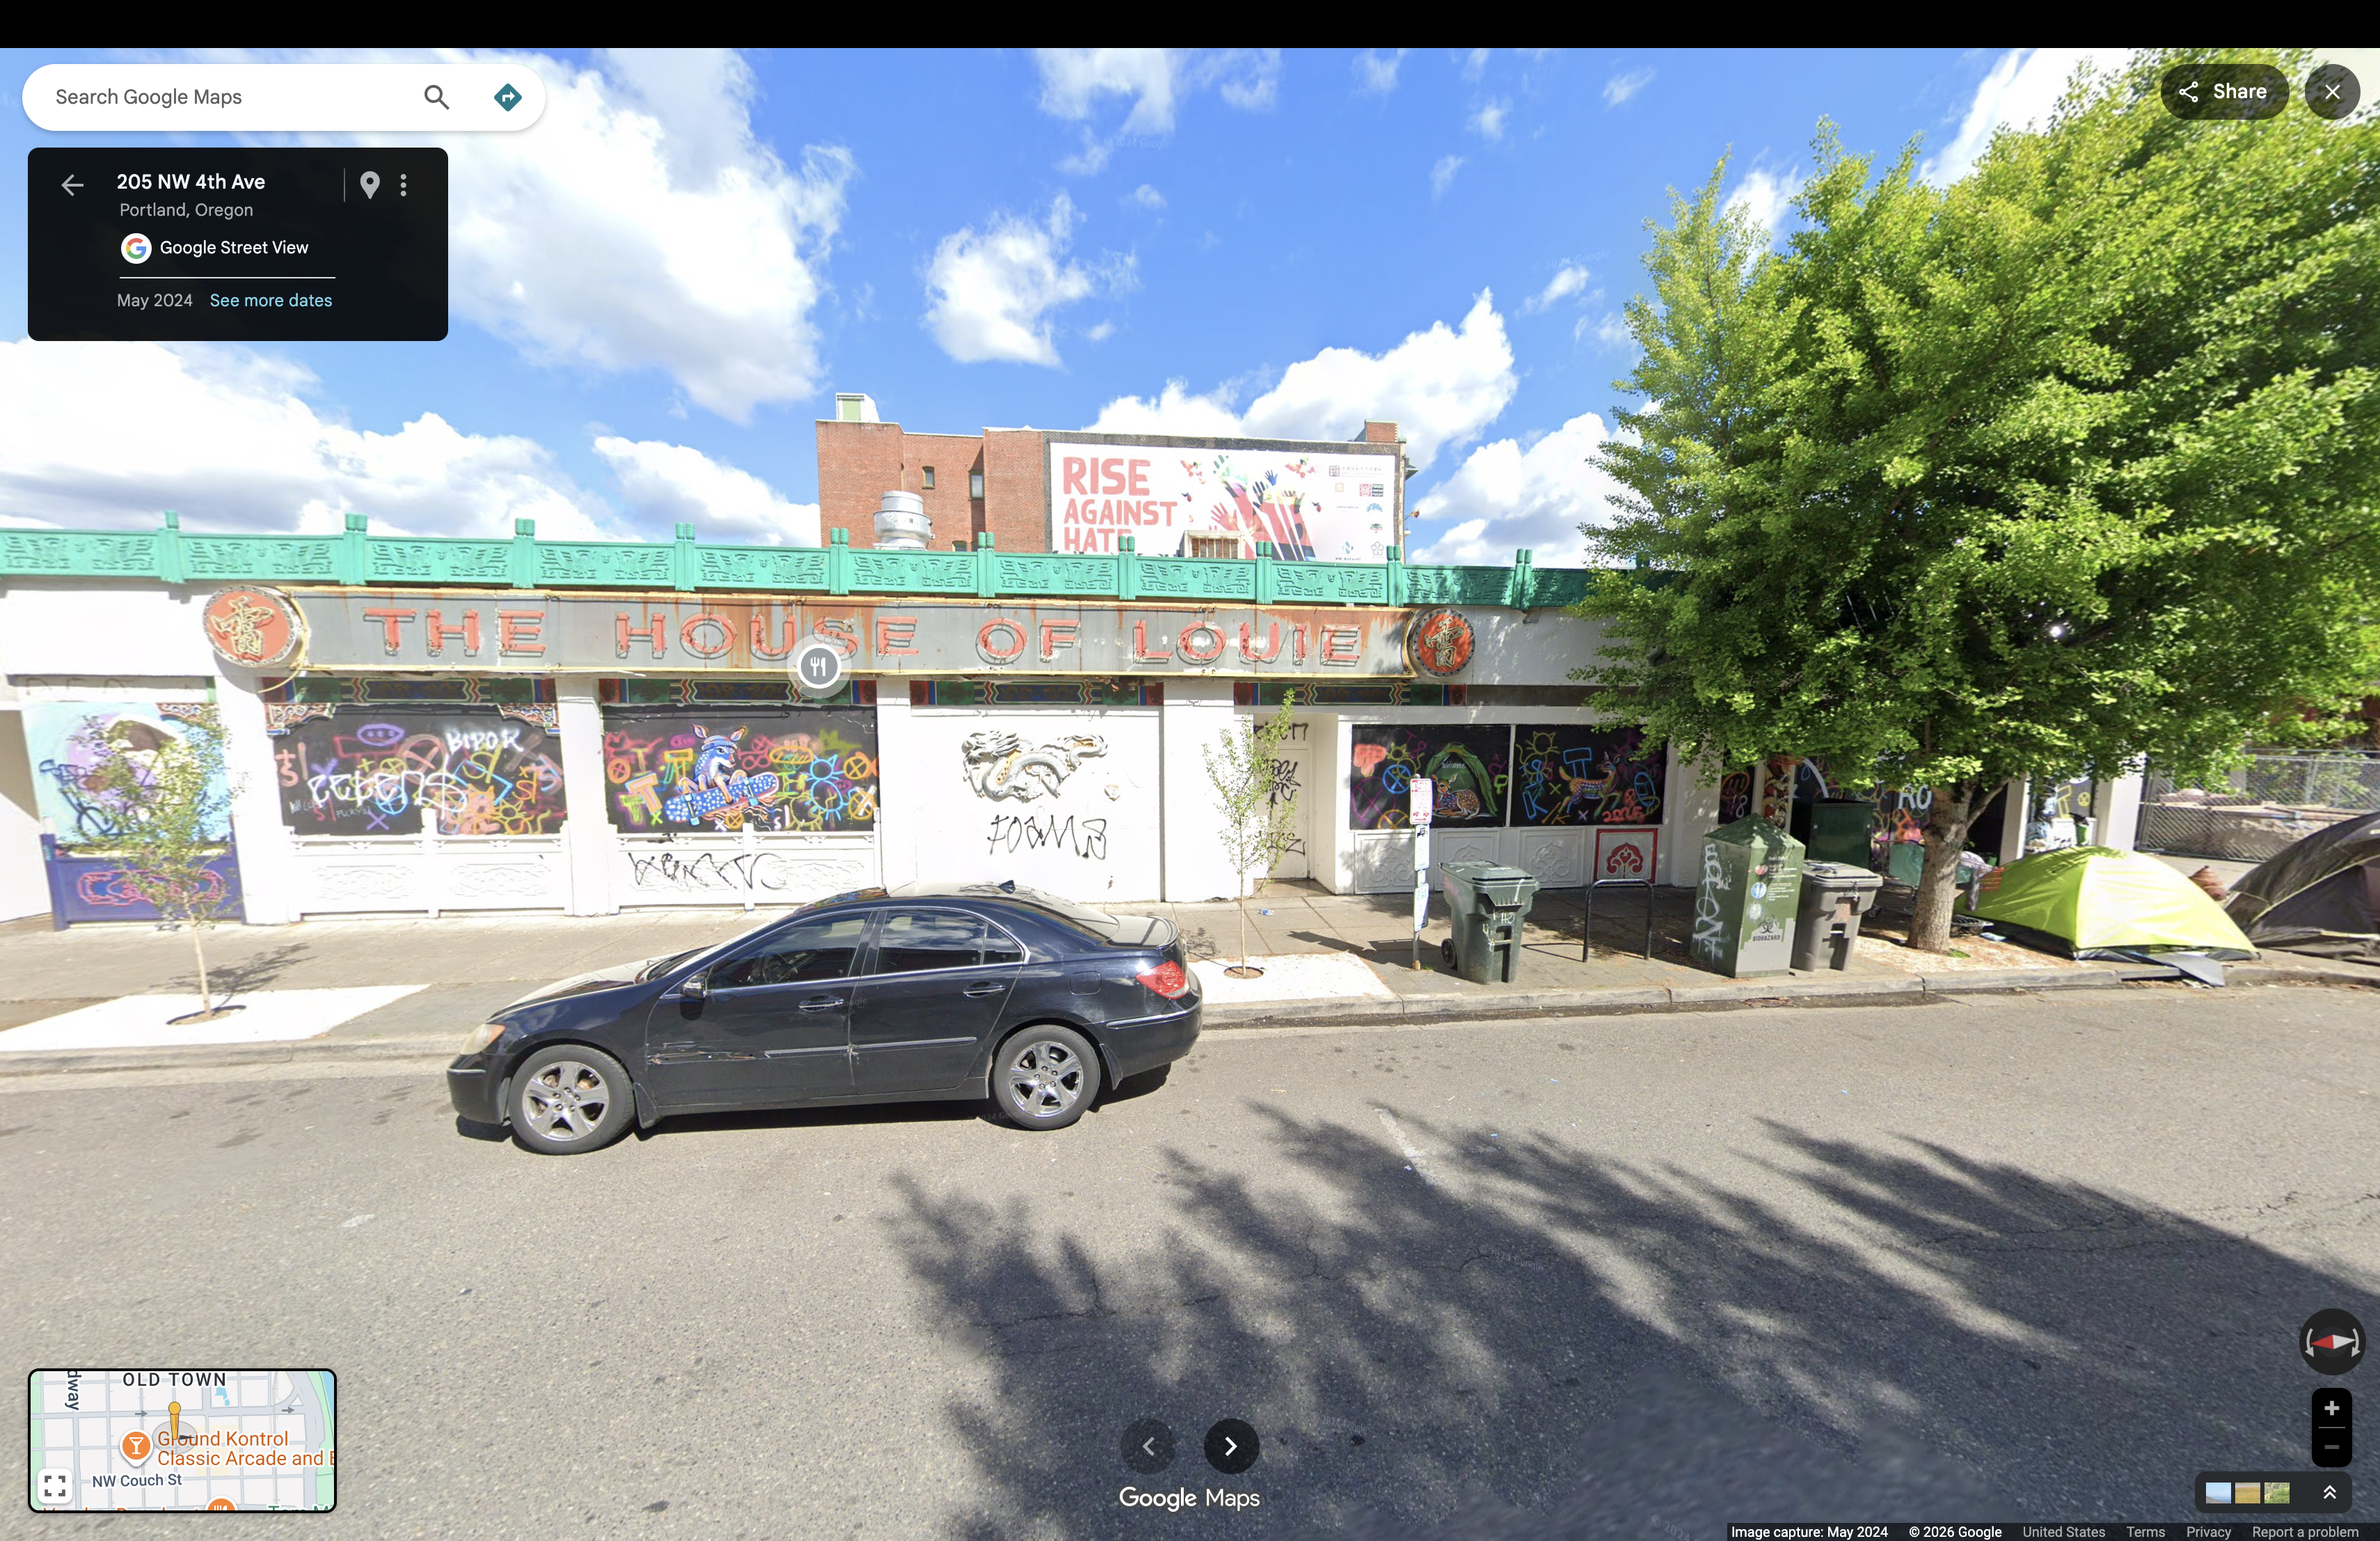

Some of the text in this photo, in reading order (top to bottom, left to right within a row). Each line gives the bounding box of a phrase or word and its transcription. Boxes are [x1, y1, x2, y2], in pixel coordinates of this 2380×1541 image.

[1063, 457, 1151, 497] RISE
[1064, 498, 1177, 527] AGAINST
[363, 608, 1362, 665] THE HOUSE OF LOUIE
